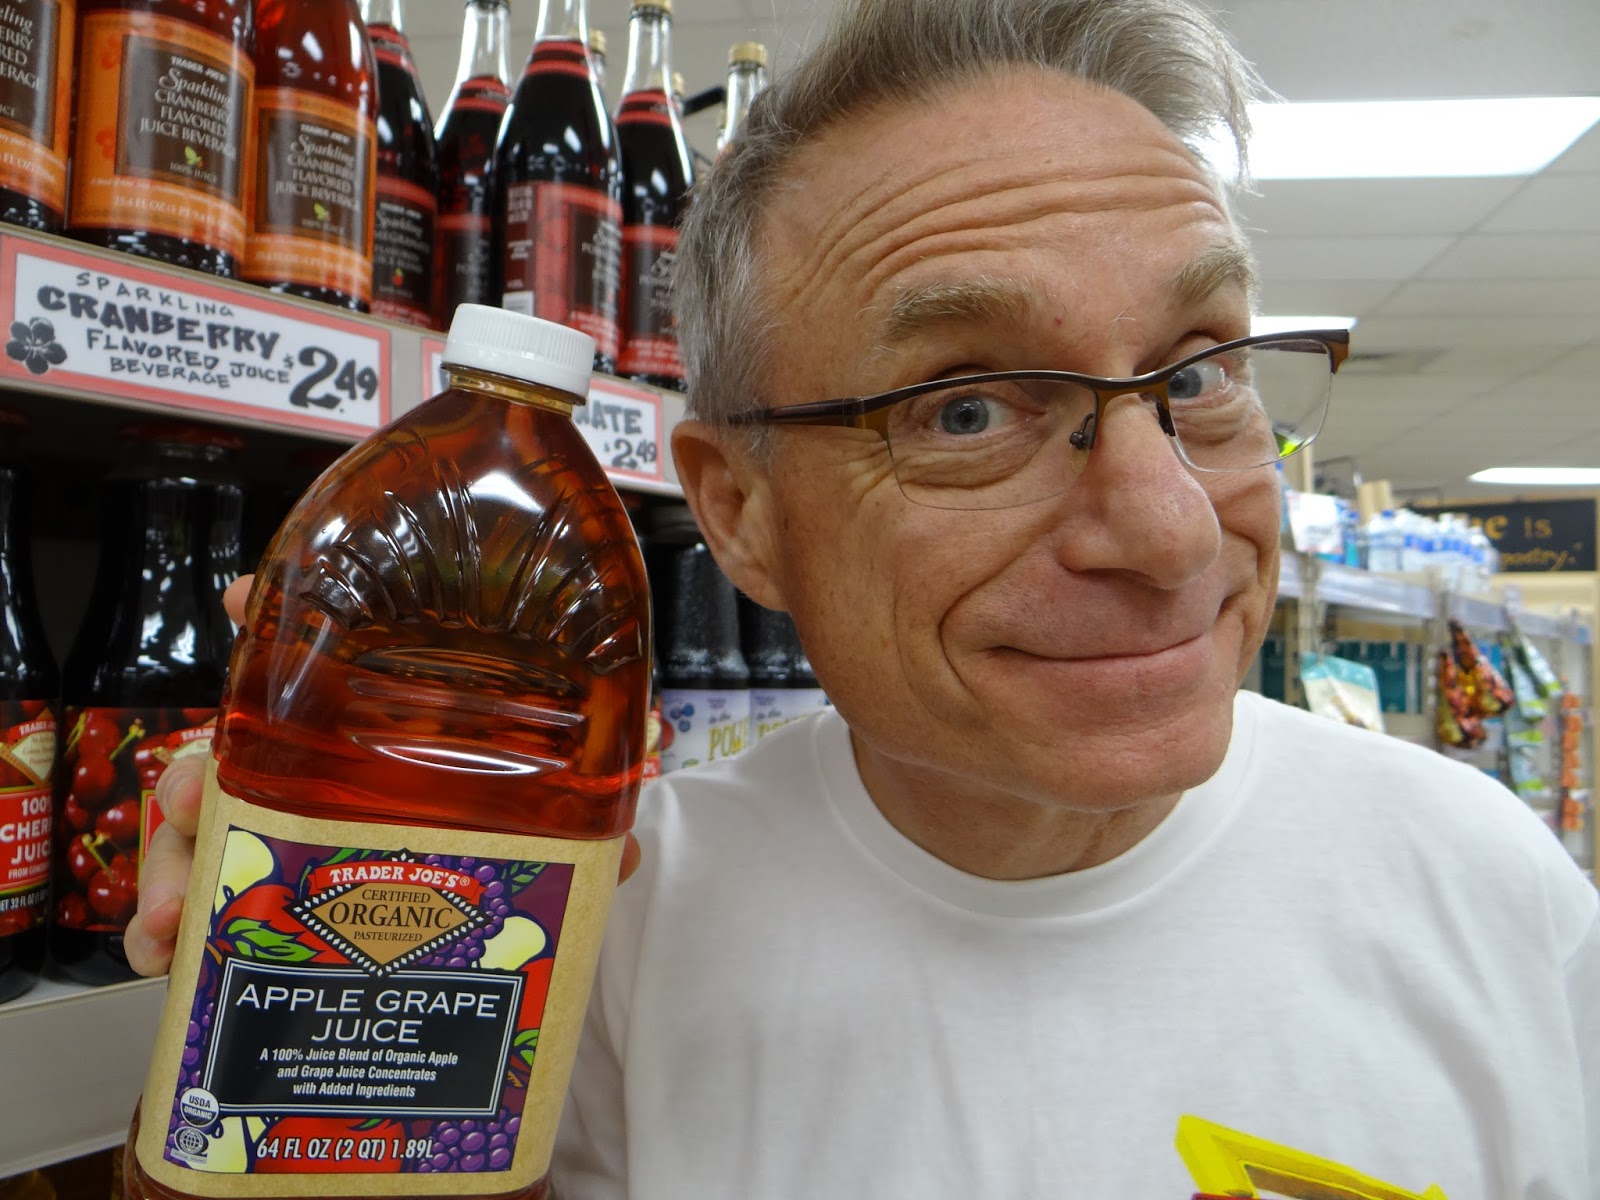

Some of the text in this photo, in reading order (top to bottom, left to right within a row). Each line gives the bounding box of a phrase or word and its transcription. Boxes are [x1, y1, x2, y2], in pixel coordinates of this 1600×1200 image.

[154, 88, 232, 122] CRANBERRY
[140, 117, 180, 138] JUICE
[160, 105, 227, 138] FLAVORED
[76, 272, 234, 317] SPARKLING
[37, 285, 280, 360] CRANBERRY
[86, 328, 290, 384] FLAVORED JUICE
[110, 357, 231, 388] BEVERAGE
[181, 727, 216, 741] TRADE
[11, 840, 50, 865] JUIC
[8, 867, 28, 880] FROM
[329, 866, 404, 883] TRADER
[362, 889, 431, 903] CERTIFIED
[329, 902, 453, 929] ORGANIC
[353, 931, 423, 942] PASTEURIZED
[236, 983, 500, 1018] APPLE GRAPE
[311, 1019, 423, 1043] JUICE
[260, 1048, 458, 1066] A 100% Juice Blend of Organic Apple
[277, 1065, 437, 1081] and Grape Juice Concentrates
[188, 1094, 211, 1109] USDA
[293, 1082, 416, 1099] with Added Ingredients
[184, 1105, 213, 1120] ORGANIC
[257, 1137, 434, 1161] 64 FL OZ (2 QT) 1.89L
